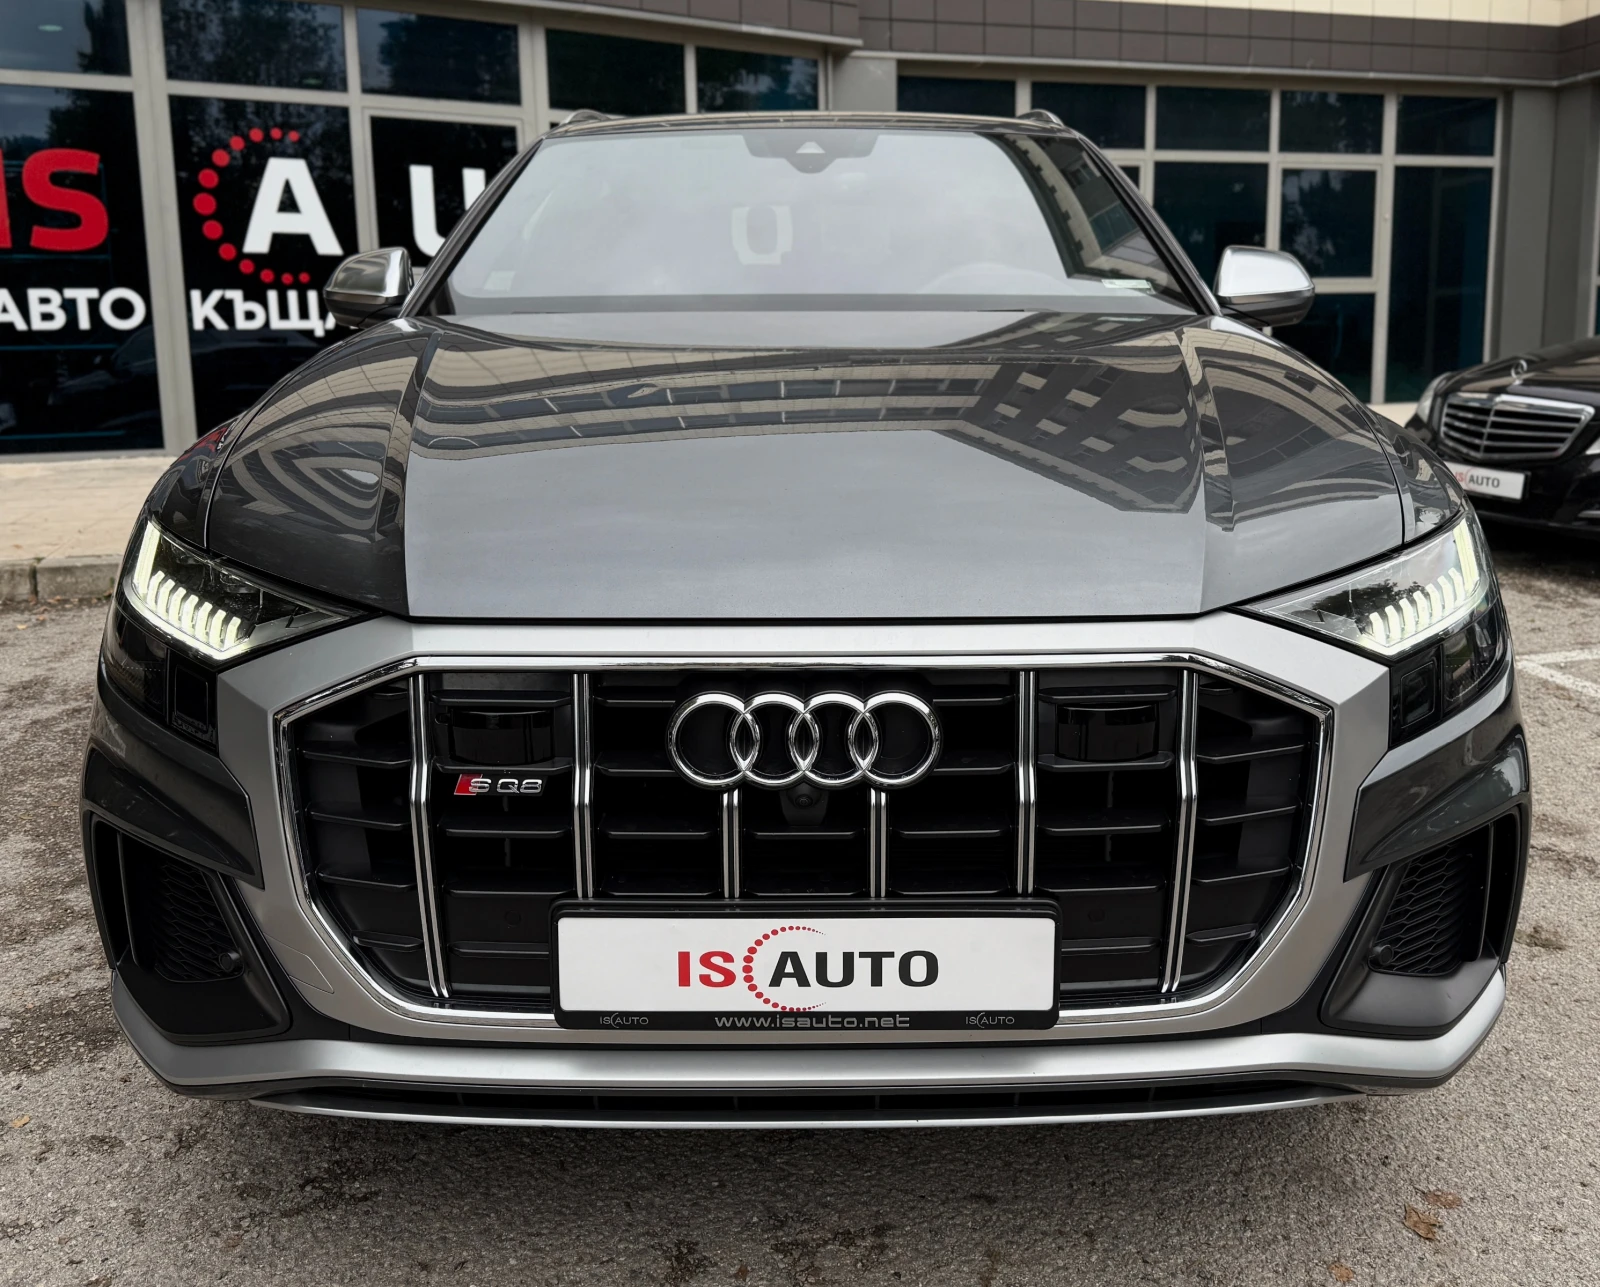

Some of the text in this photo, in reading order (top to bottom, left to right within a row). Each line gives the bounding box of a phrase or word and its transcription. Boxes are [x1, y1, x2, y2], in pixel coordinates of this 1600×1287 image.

[190, 288, 337, 337] КЪЩ
[678, 950, 939, 988] IS AUTO
[715, 1014, 910, 1028] www.isauto.net
